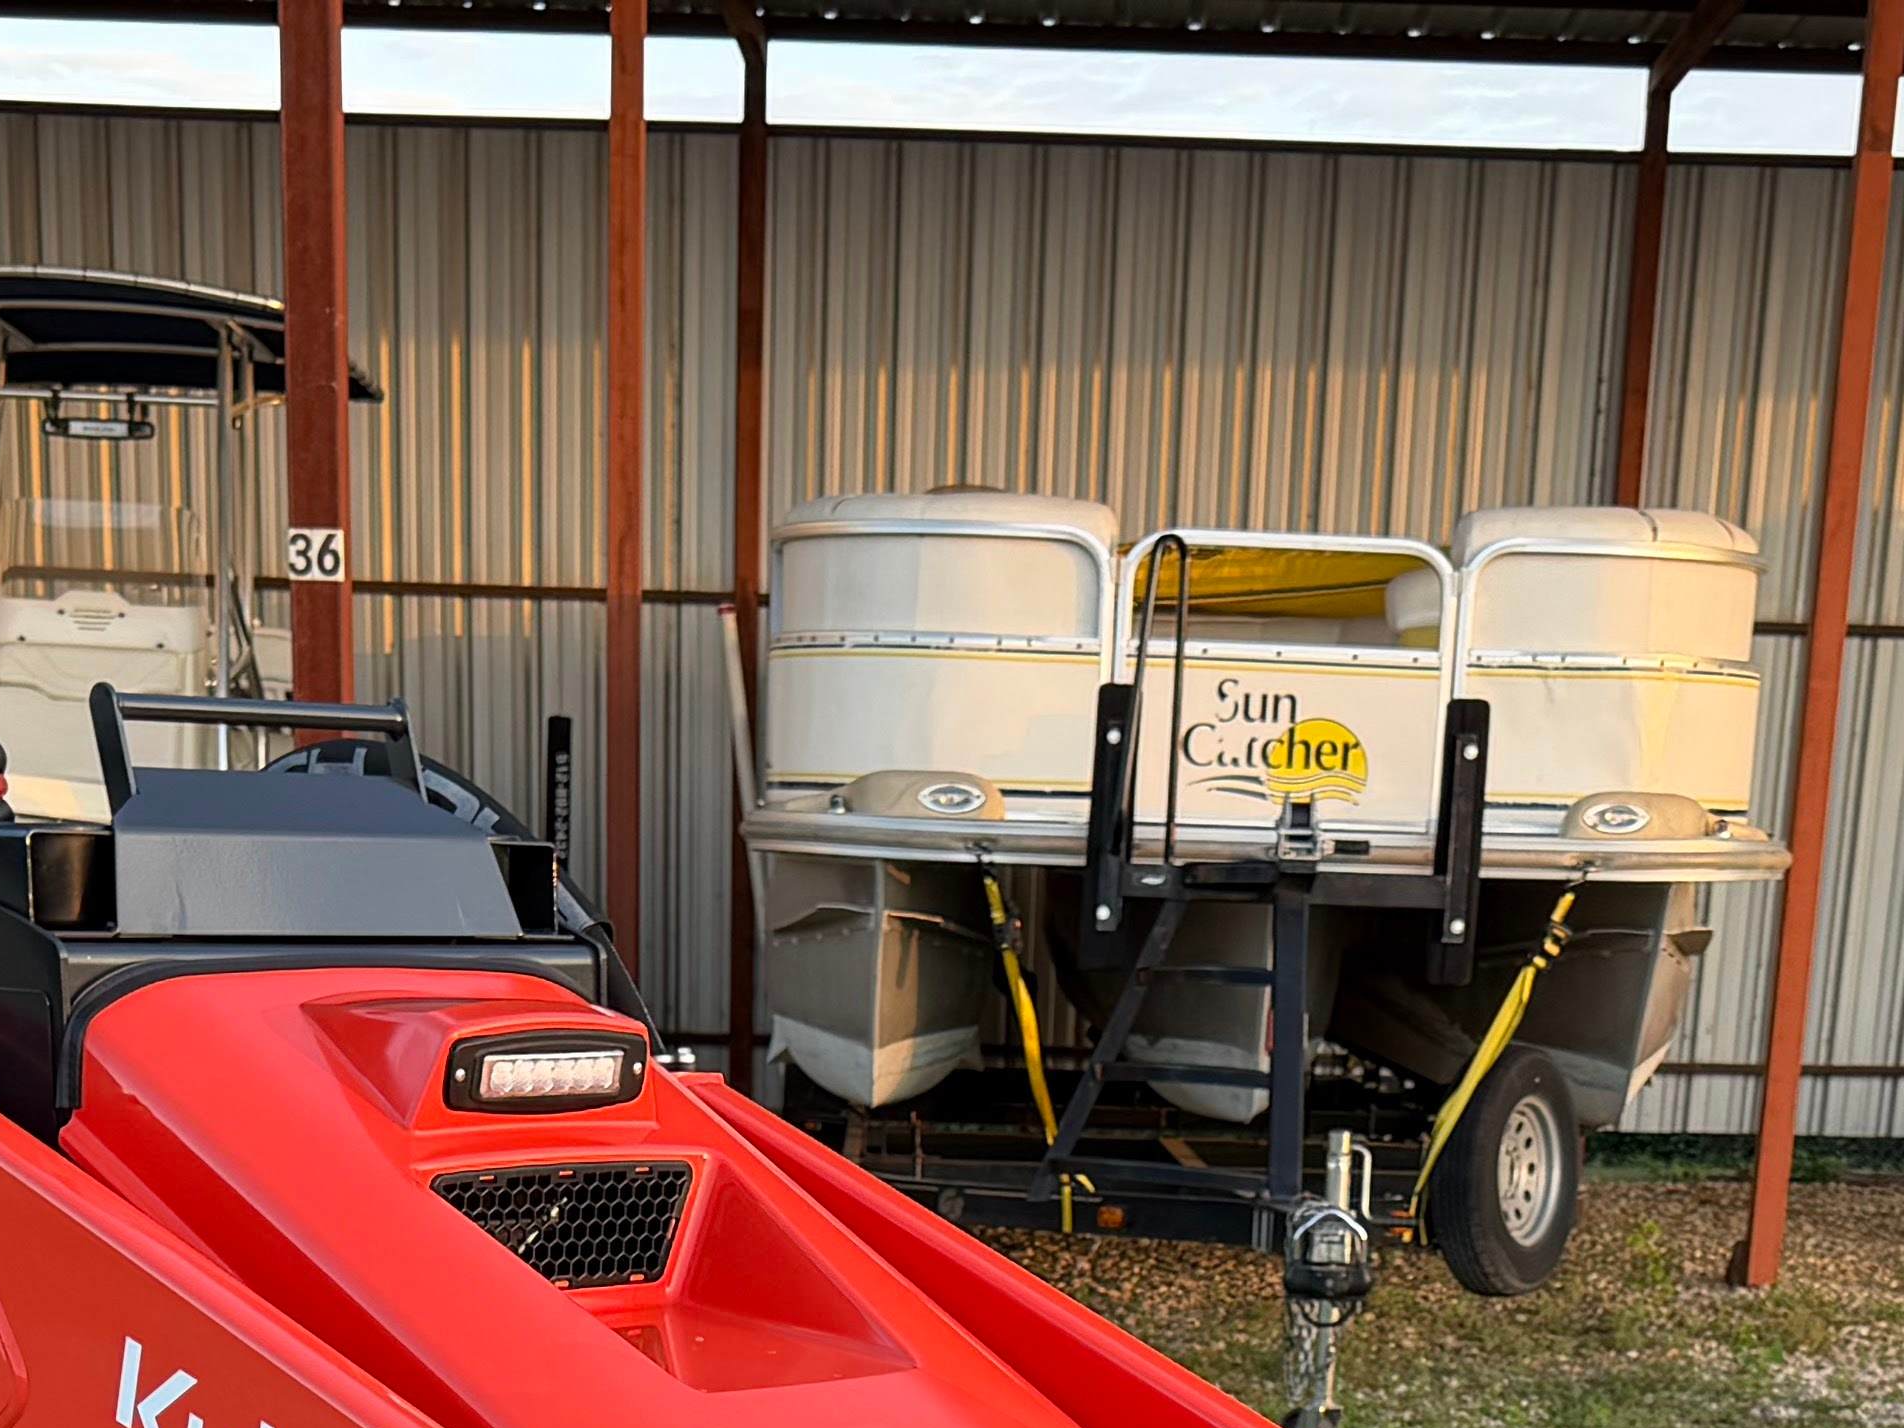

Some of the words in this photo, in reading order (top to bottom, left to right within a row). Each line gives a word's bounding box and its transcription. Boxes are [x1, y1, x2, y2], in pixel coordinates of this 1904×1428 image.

[289, 533, 341, 576] 36
[1216, 678, 1297, 723] Sun
[1183, 722, 1360, 771] Catcher
